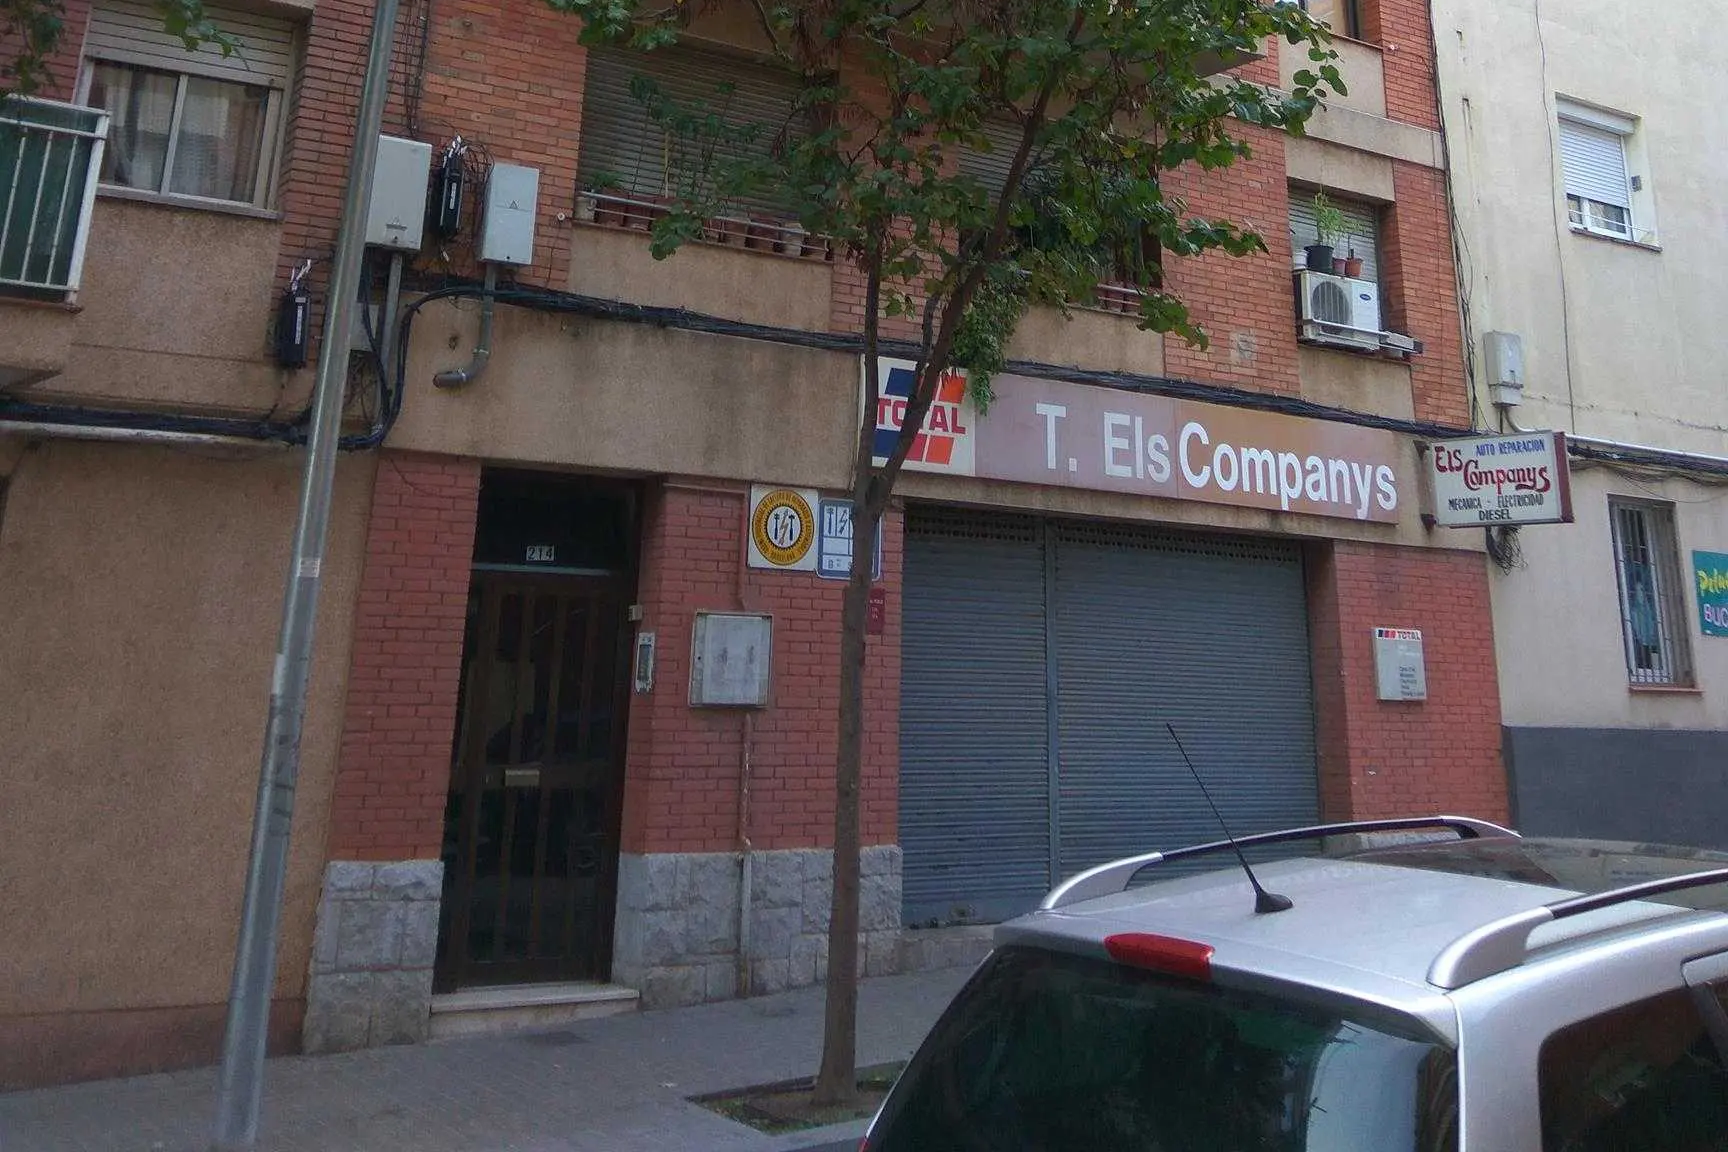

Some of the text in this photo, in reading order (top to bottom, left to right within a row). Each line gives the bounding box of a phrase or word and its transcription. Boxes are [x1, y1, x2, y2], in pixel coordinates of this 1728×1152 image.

[878, 398, 966, 434] TOAL
[1476, 443, 1496, 457] AUTO
[1036, 402, 1398, 520] T. Els Companys
[1478, 508, 1512, 521] DIESEL
[1397, 630, 1421, 641] TOTAL
